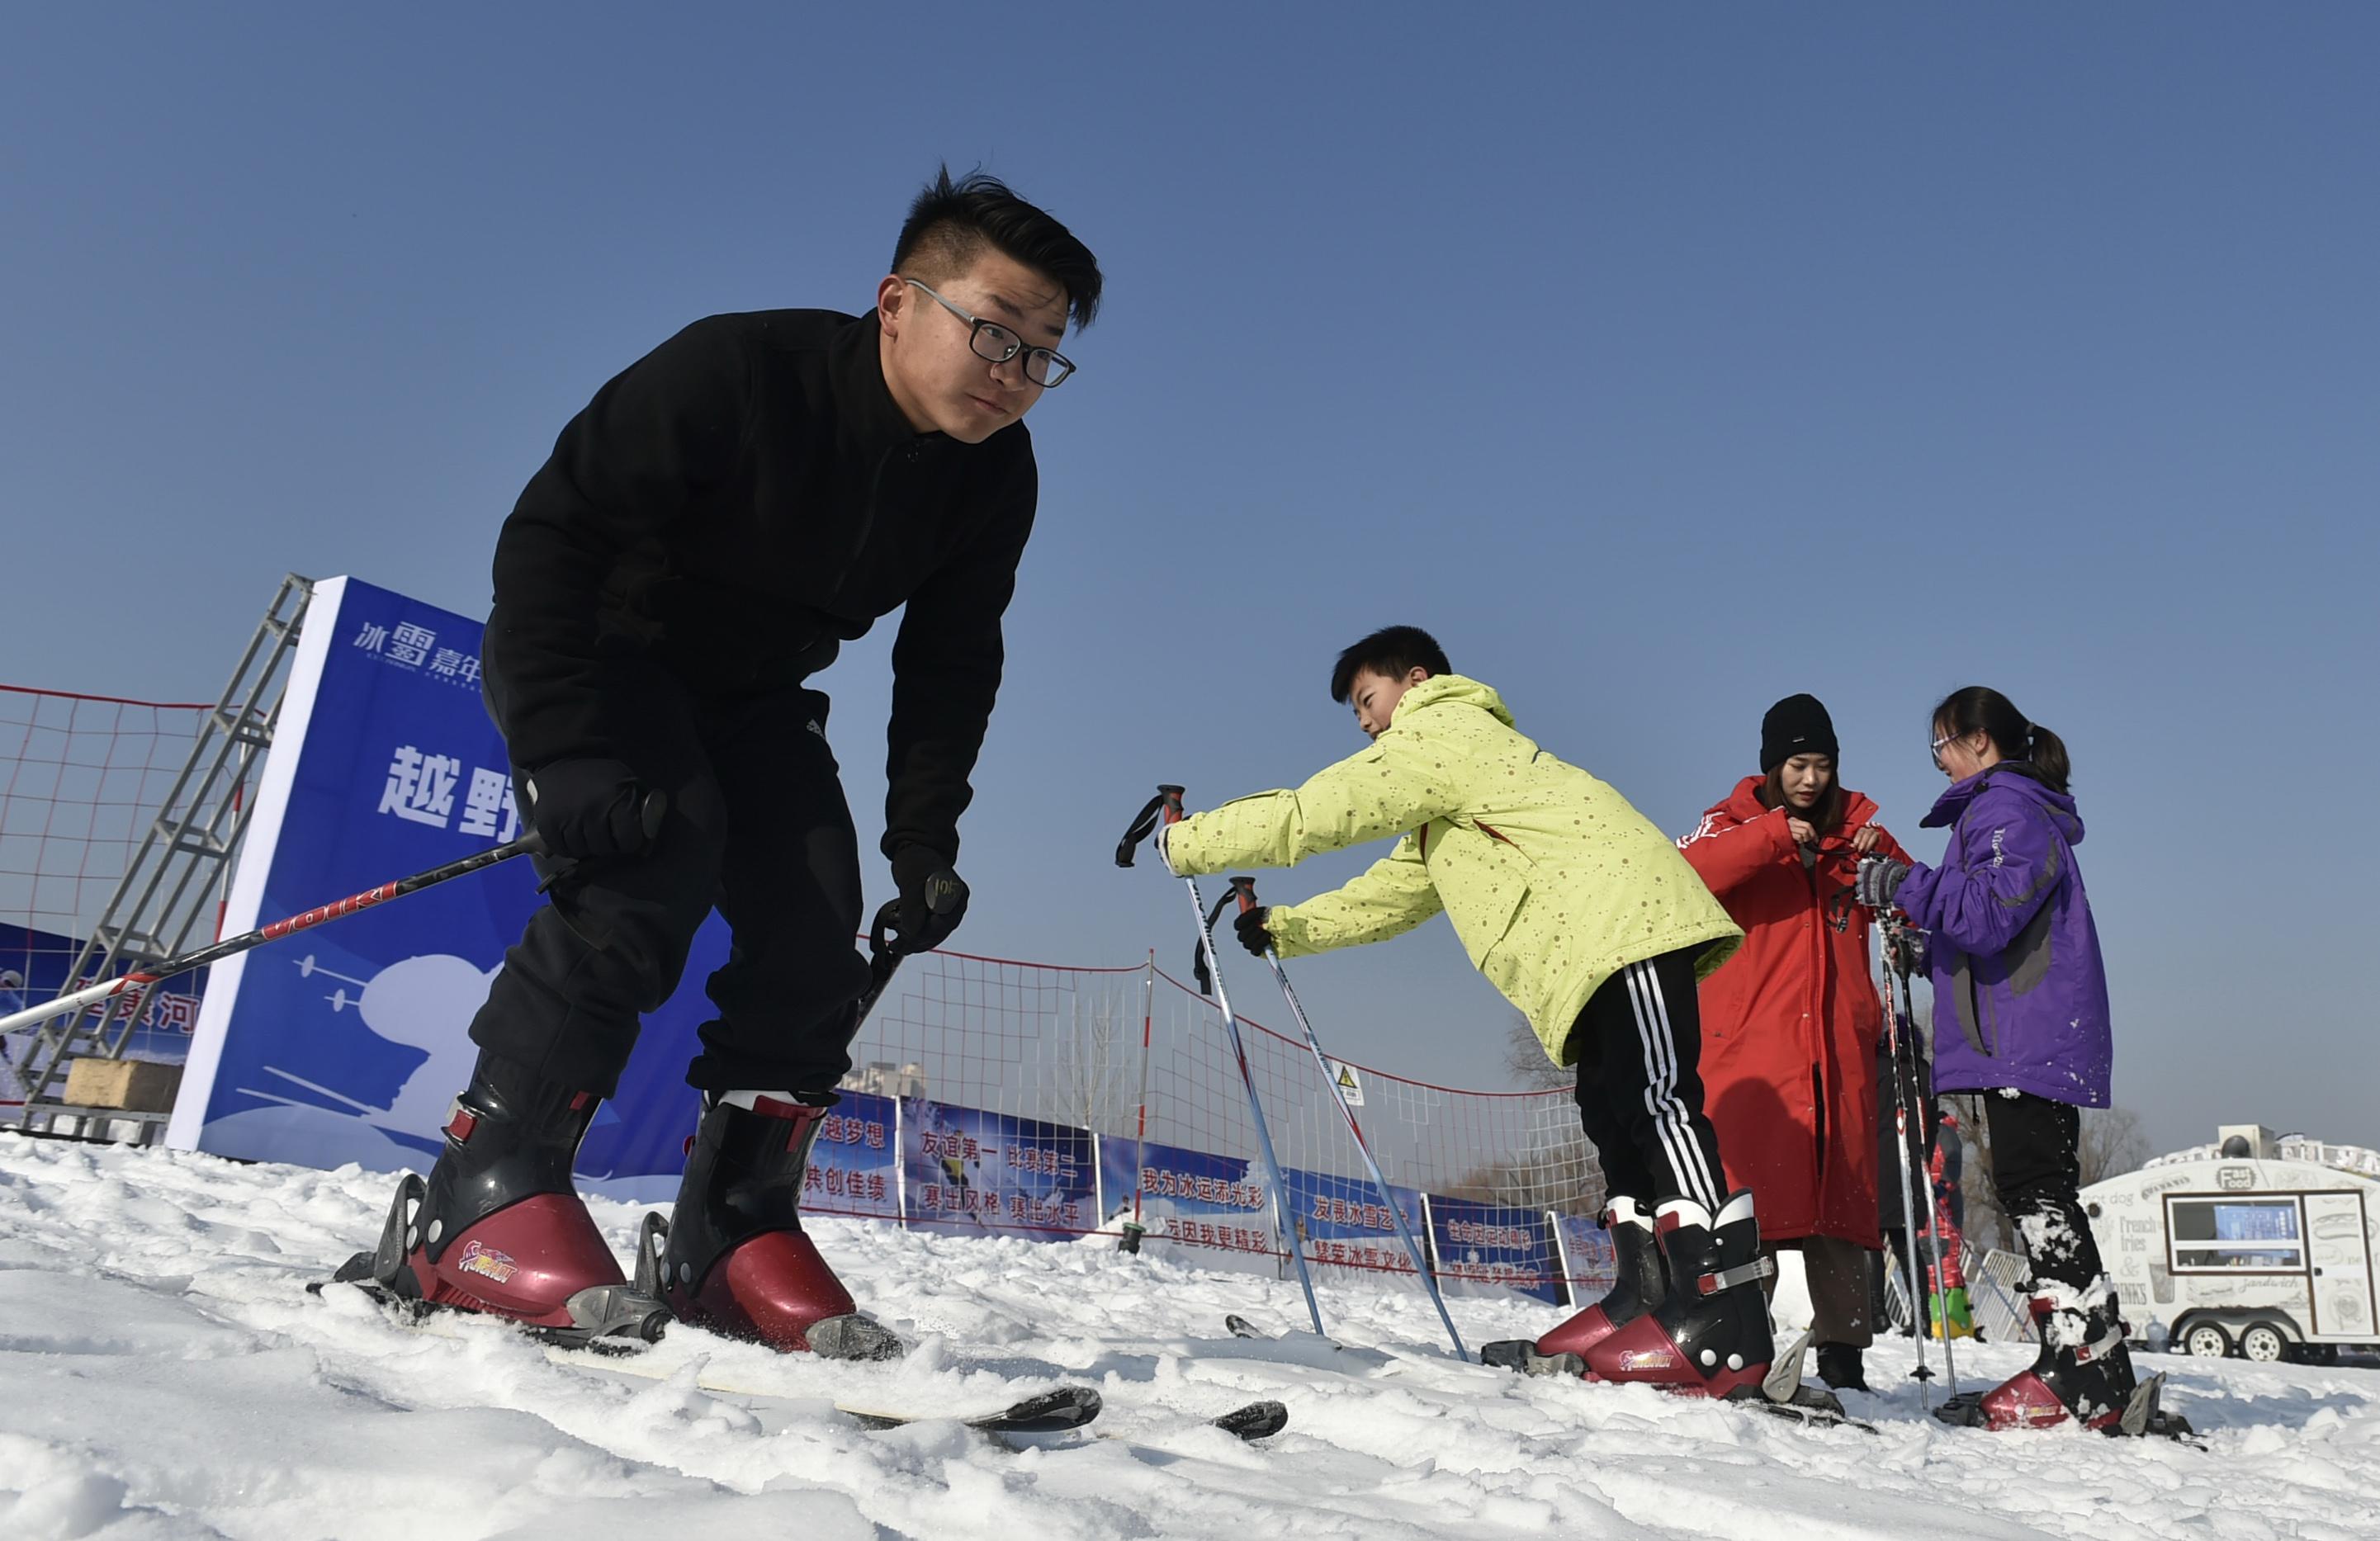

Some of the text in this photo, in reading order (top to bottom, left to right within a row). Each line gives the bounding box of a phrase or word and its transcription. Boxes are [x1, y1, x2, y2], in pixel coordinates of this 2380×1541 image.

[816, 1113, 885, 1149] 越梦想
[921, 1131, 1078, 1179] 友谊第一 比赛第二
[804, 1165, 887, 1202] 共创佳绩
[1142, 1167, 1266, 1210] 我为冰运添光彩
[2109, 1191, 2134, 1207] dog
[924, 1184, 1081, 1225] 赛出风格 赛出水平
[2119, 1256, 2141, 1277] &
